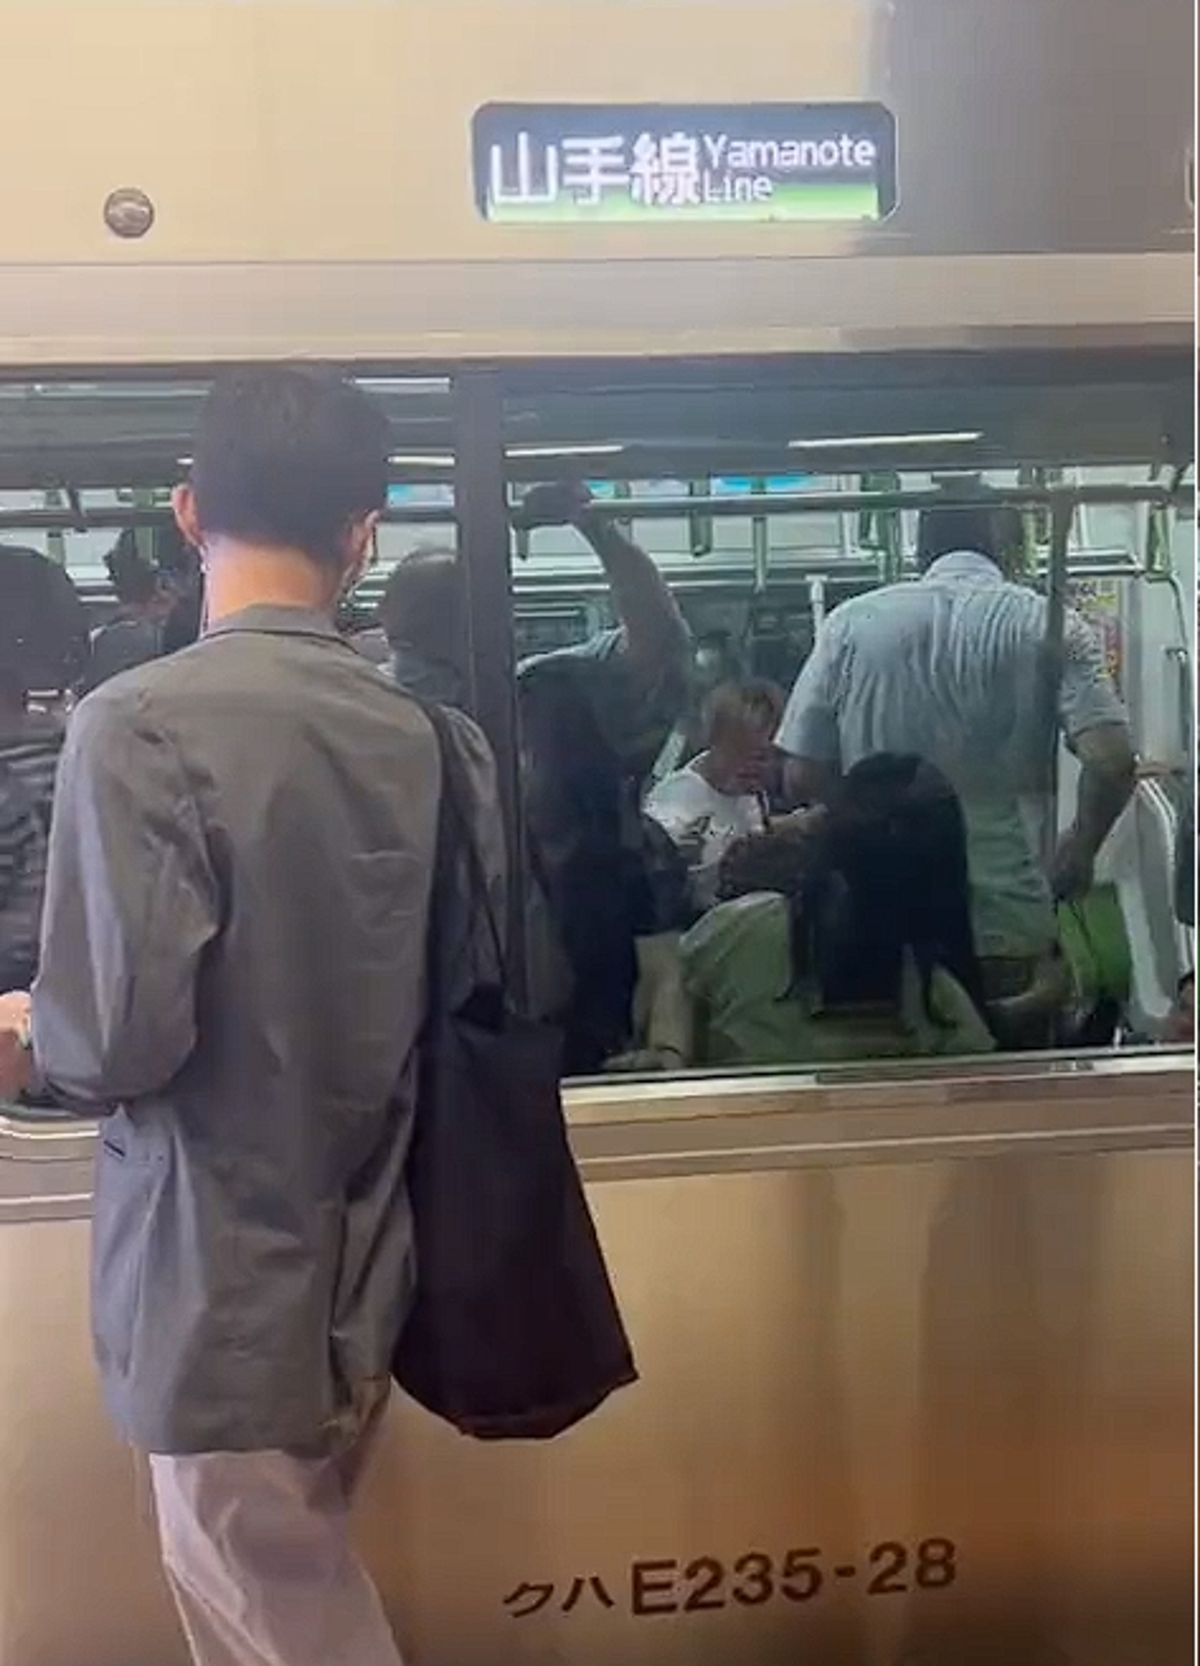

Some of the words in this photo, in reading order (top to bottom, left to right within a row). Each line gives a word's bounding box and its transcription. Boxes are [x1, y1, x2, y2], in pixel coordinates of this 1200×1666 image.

[490, 131, 701, 206] 山手線
[703, 133, 877, 169] Yamanote
[703, 174, 774, 202] Line
[503, 1576, 615, 1619] クハ
[631, 1537, 957, 1616] E235-28
